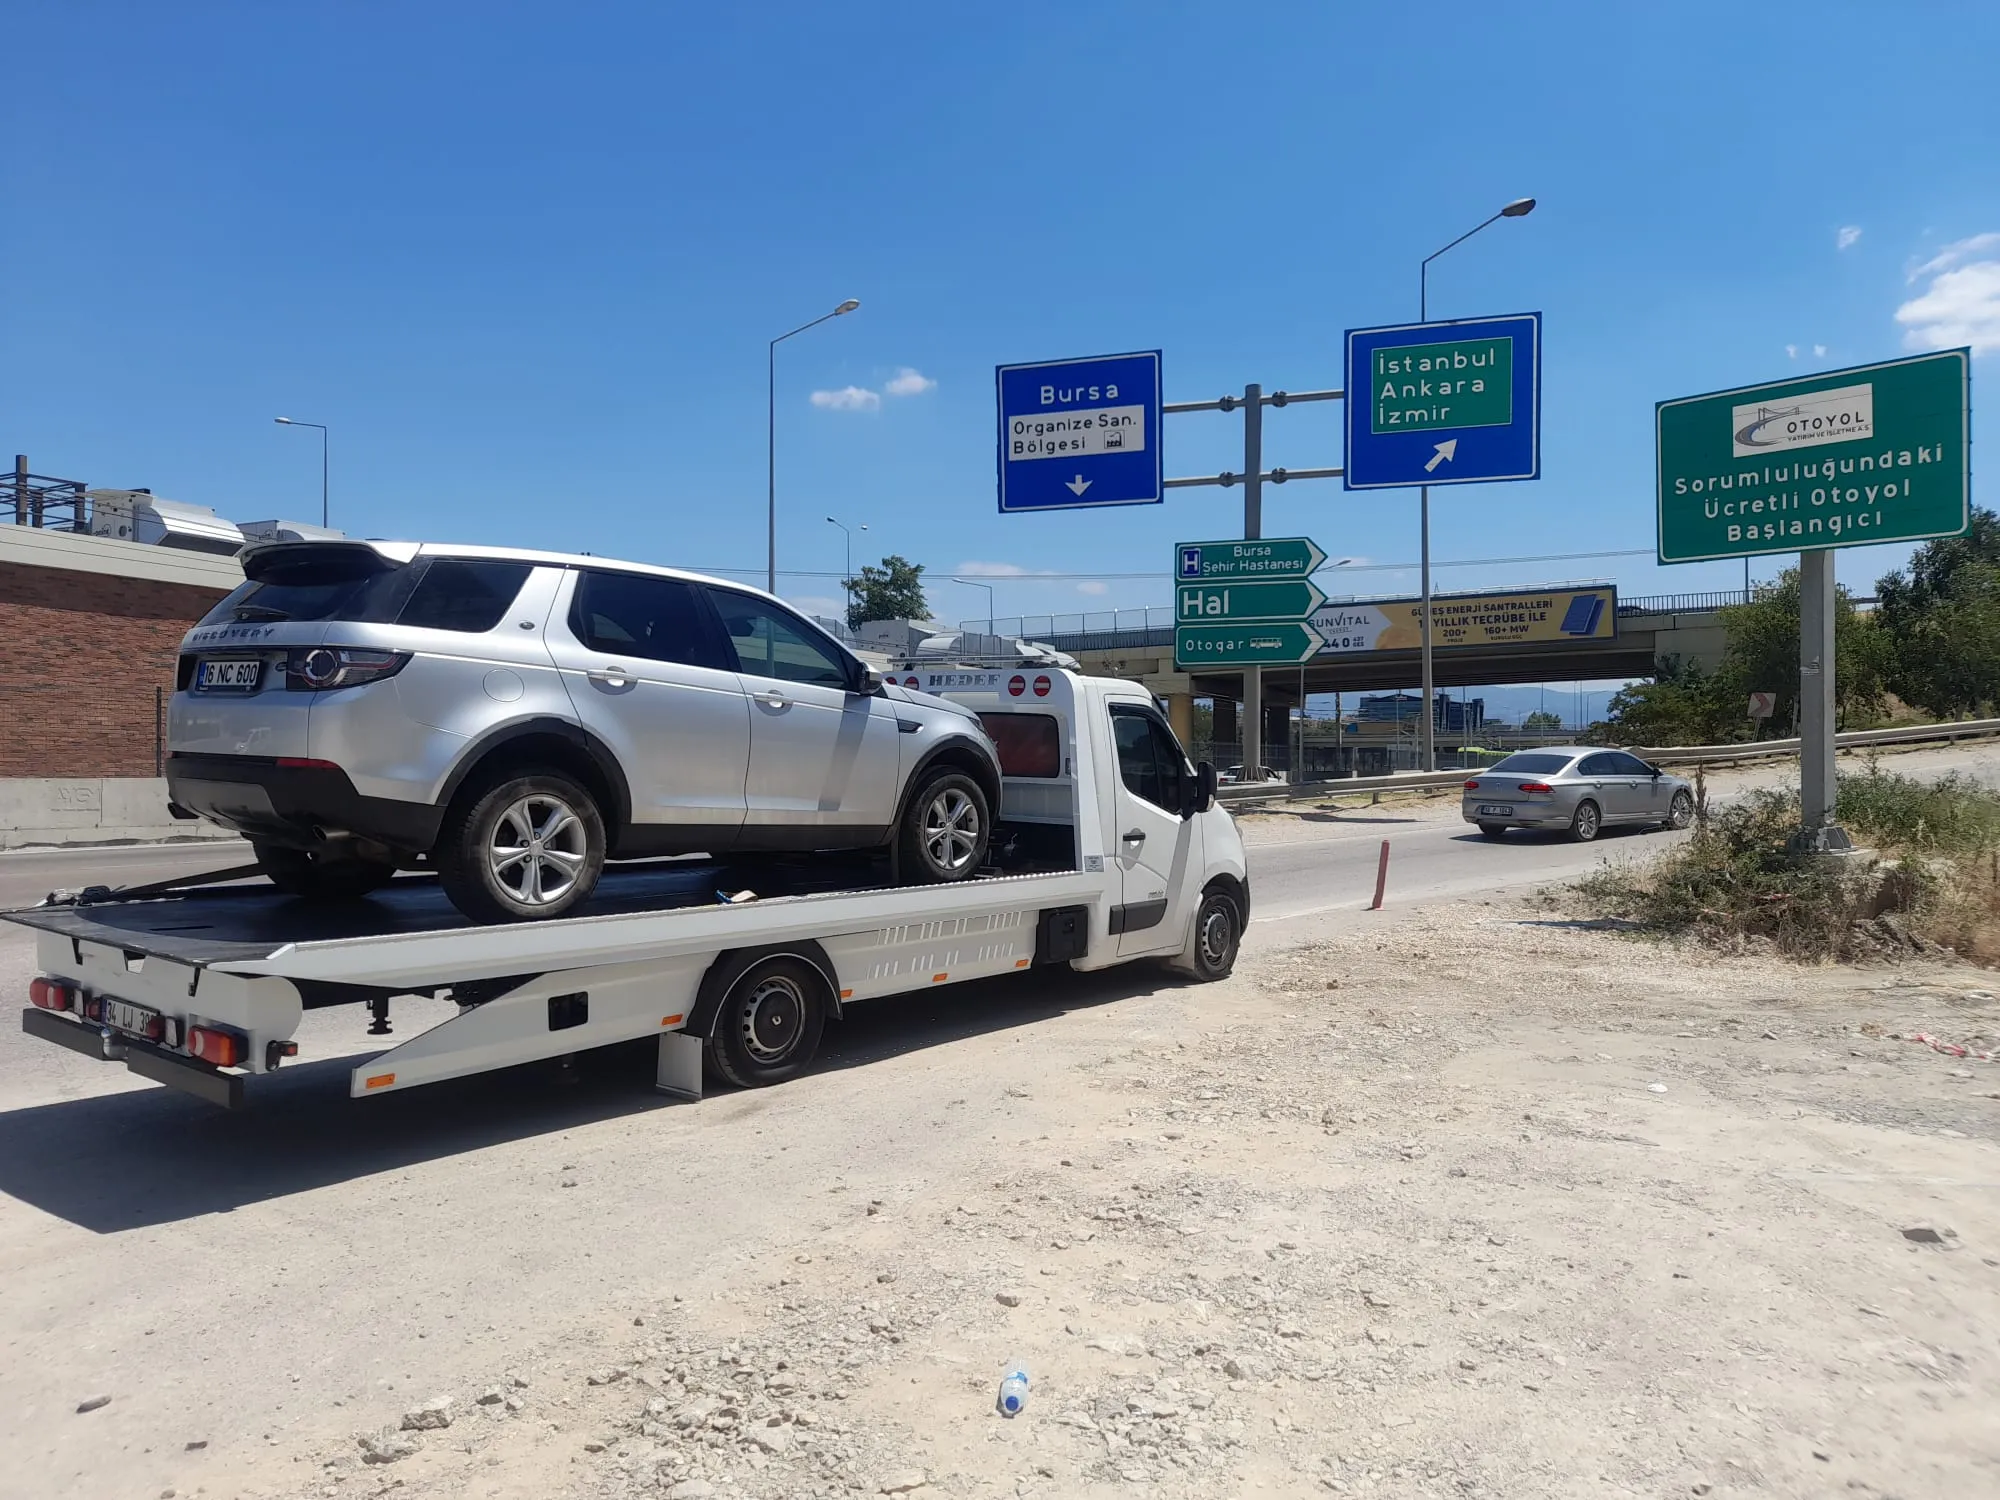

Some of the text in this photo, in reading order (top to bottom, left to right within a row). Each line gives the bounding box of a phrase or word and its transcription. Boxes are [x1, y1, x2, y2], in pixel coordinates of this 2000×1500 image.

[1379, 348, 1495, 375] İstanbul
[1040, 384, 1119, 405] Bursa
[1380, 379, 1485, 399] Ankara
[1379, 403, 1450, 425] İzmir
[1787, 411, 1865, 433] OTOYOL
[1014, 414, 1137, 436] Organize San.
[1014, 437, 1085, 455] Bölgesi
[1788, 432, 1815, 442] YATIRIM
[1816, 431, 1825, 439] VE
[1675, 443, 1943, 494] Sorumluluğundaki
[1704, 478, 1910, 519] Ücretli Otoyol
[1727, 511, 1881, 542] Başlangıcı
[1233, 545, 1271, 558] Bursa
[1202, 561, 1235, 576] Şehir
[1183, 589, 1230, 616] Hal
[1446, 602, 1481, 615] ENERJİ
[1484, 598, 1553, 612] SANTRALLERİ
[1432, 615, 1470, 627] YILLIK
[1471, 610, 1526, 625] TECRÜBE
[1528, 609, 1547, 622] İLE
[1442, 628, 1466, 638] 200+
[1484, 624, 1529, 635] 160+ MW
[1185, 639, 1245, 654] Otogar
[205, 664, 258, 684] 16 NC 600
[929, 674, 1001, 687] HEDEF
[106, 1001, 117, 1024] 34
[122, 1005, 134, 1029] LJ
